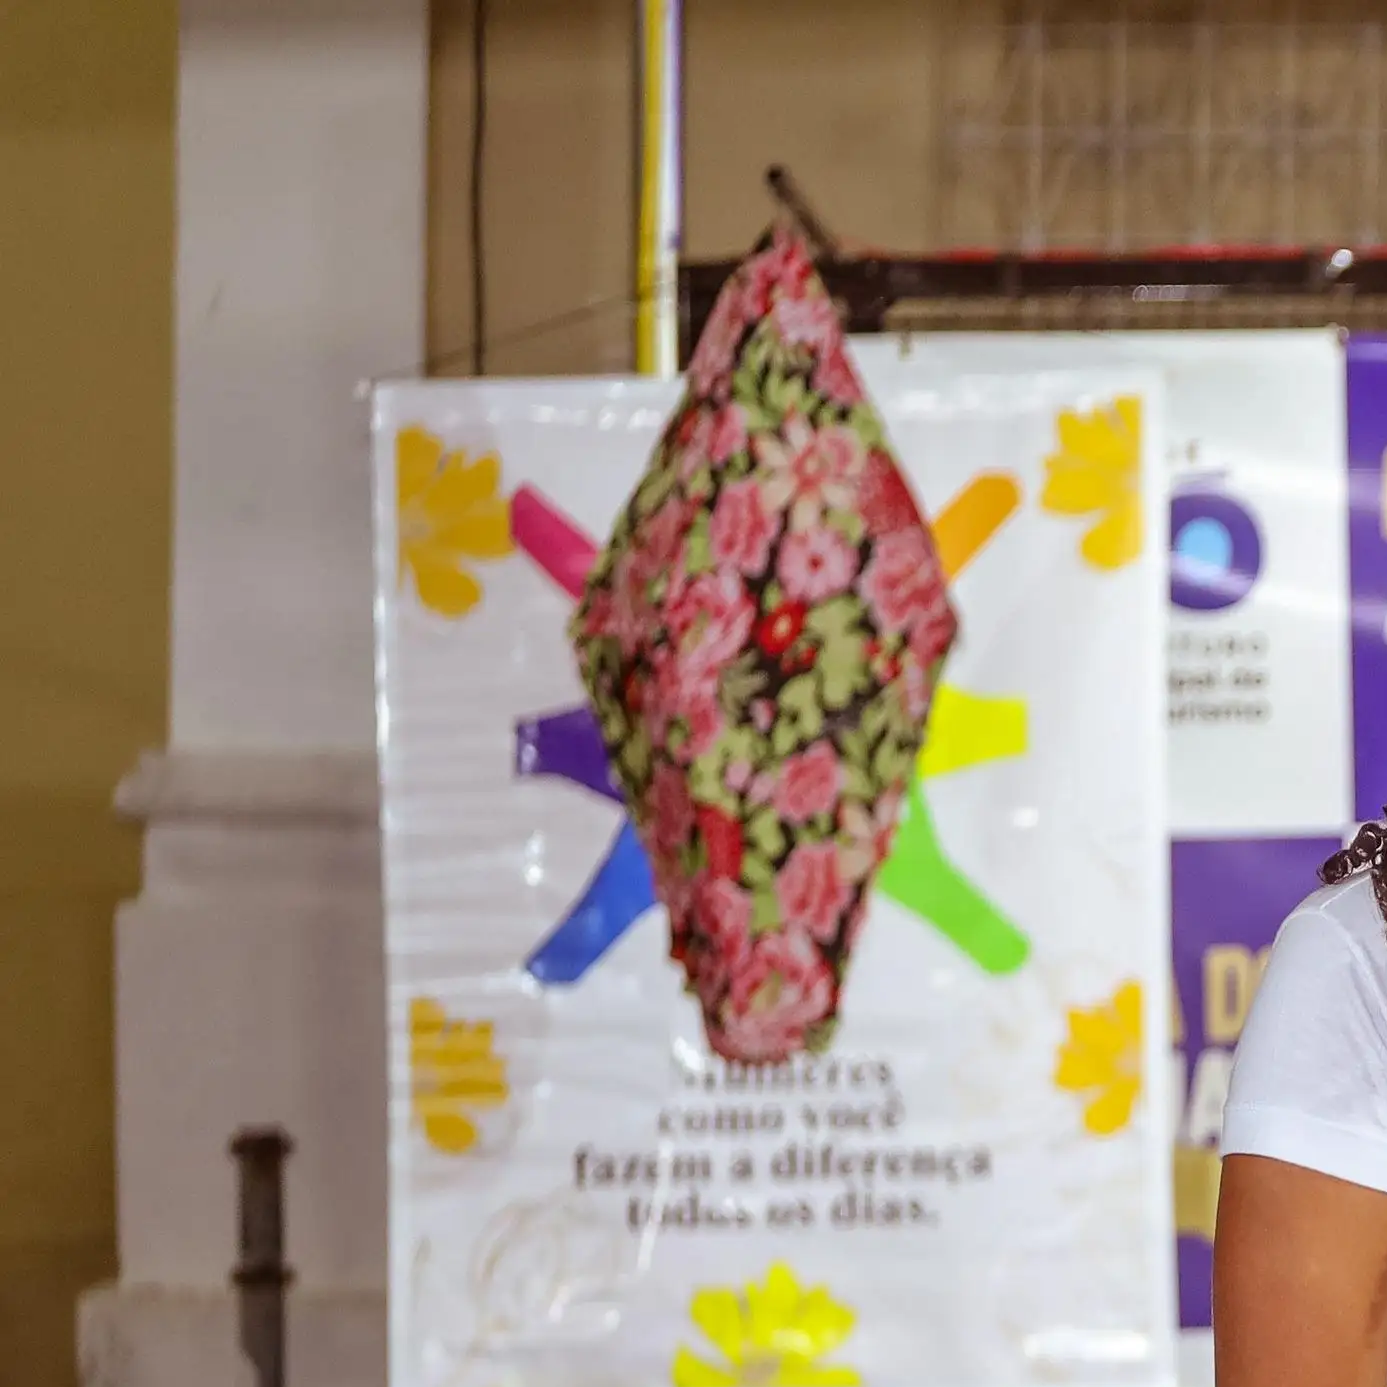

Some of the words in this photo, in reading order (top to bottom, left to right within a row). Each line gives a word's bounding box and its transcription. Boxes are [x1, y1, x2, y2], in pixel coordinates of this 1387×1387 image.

[656, 1104, 785, 1132] como
[573, 1142, 713, 1188] fazem
[729, 1150, 756, 1180] a
[769, 1141, 993, 1184] diferença
